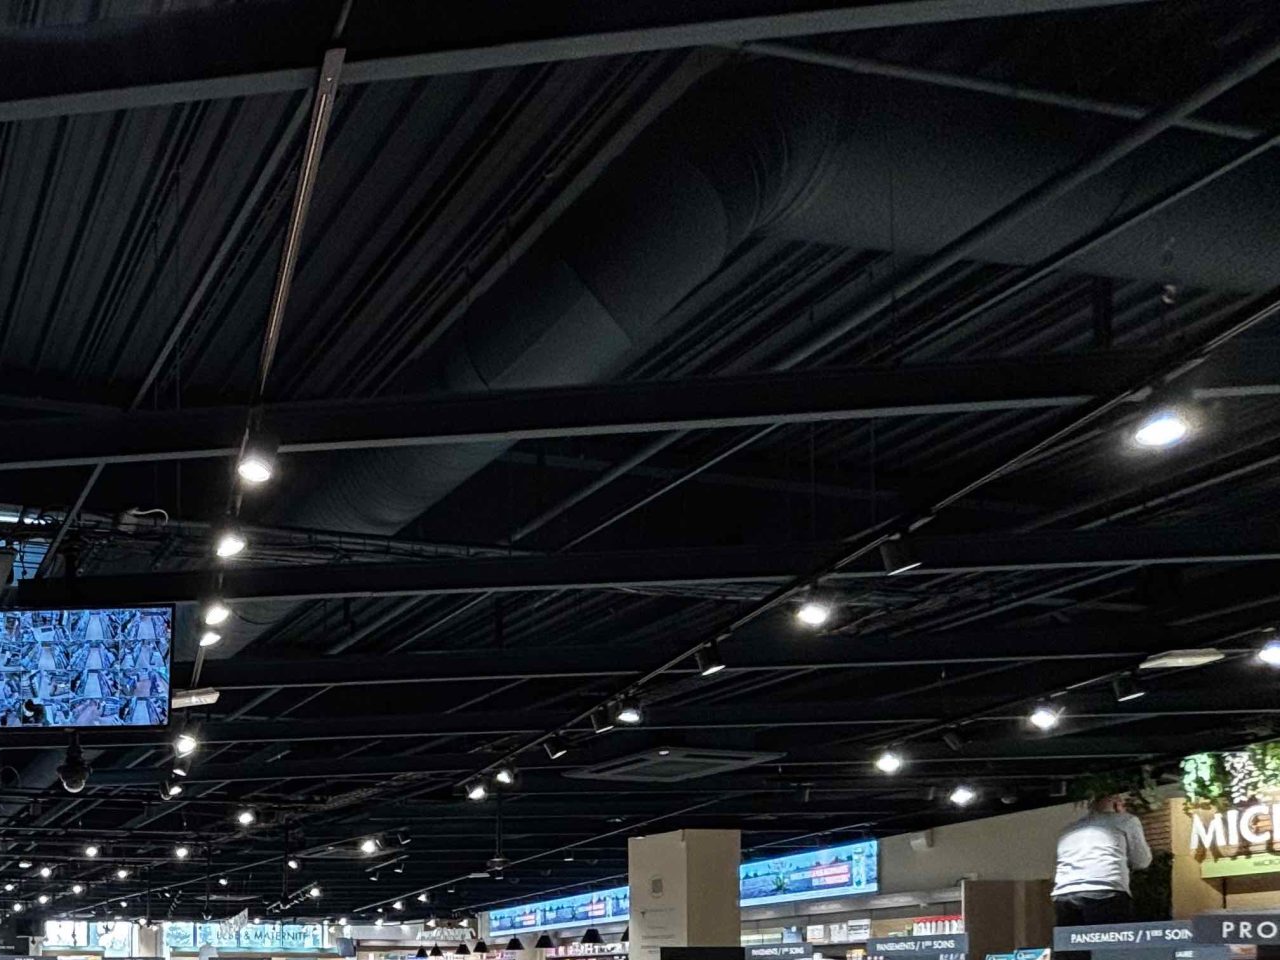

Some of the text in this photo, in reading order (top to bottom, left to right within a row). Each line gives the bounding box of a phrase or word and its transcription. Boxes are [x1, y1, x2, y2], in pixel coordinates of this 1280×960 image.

[1071, 931, 1134, 943] PANSEMENTS
[1136, 930, 1143, 943] /
[1165, 929, 1193, 940] SOIN
[933, 940, 955, 949] SOINS
